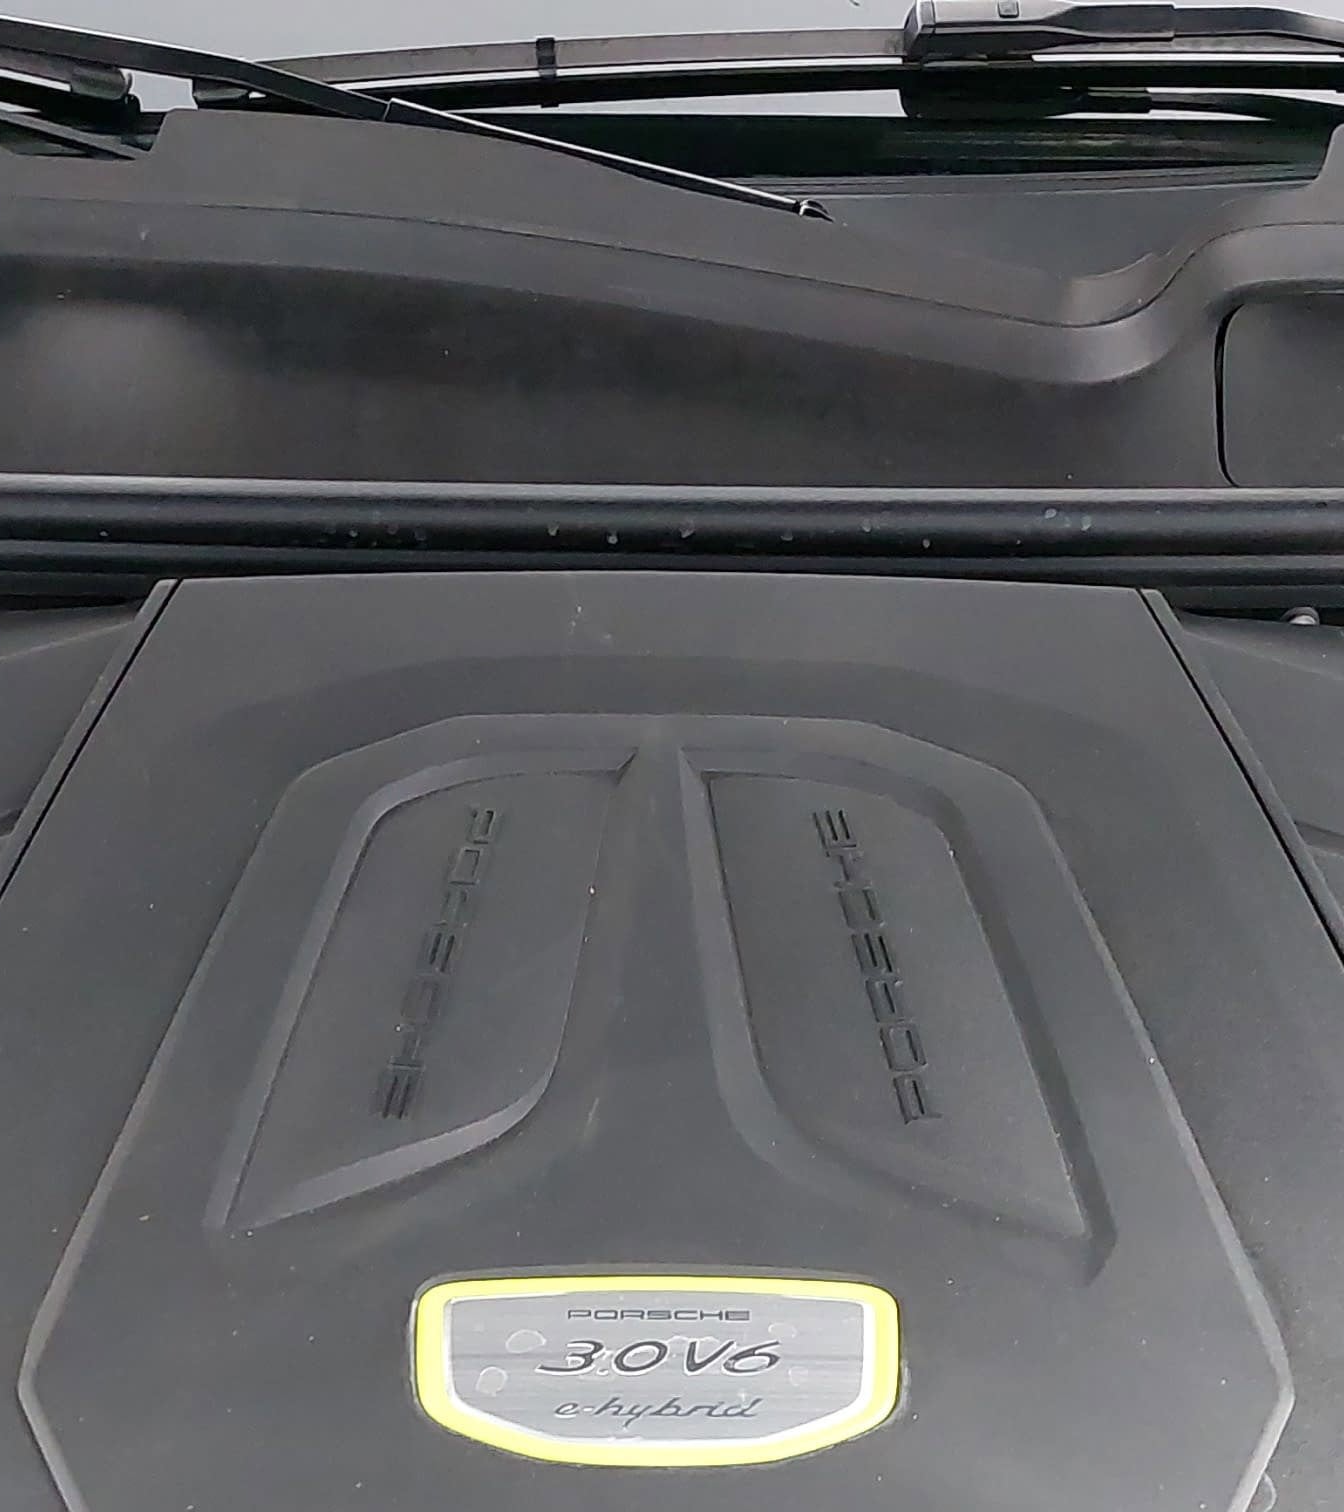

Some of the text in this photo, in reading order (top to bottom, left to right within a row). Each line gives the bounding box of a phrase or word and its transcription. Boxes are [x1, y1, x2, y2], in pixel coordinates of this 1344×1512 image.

[376, 808, 502, 1119] PORSCHE
[812, 809, 940, 1124] PORSCHE
[567, 1309, 751, 1322] PORSCHE
[553, 1396, 764, 1432] e-hybrid
